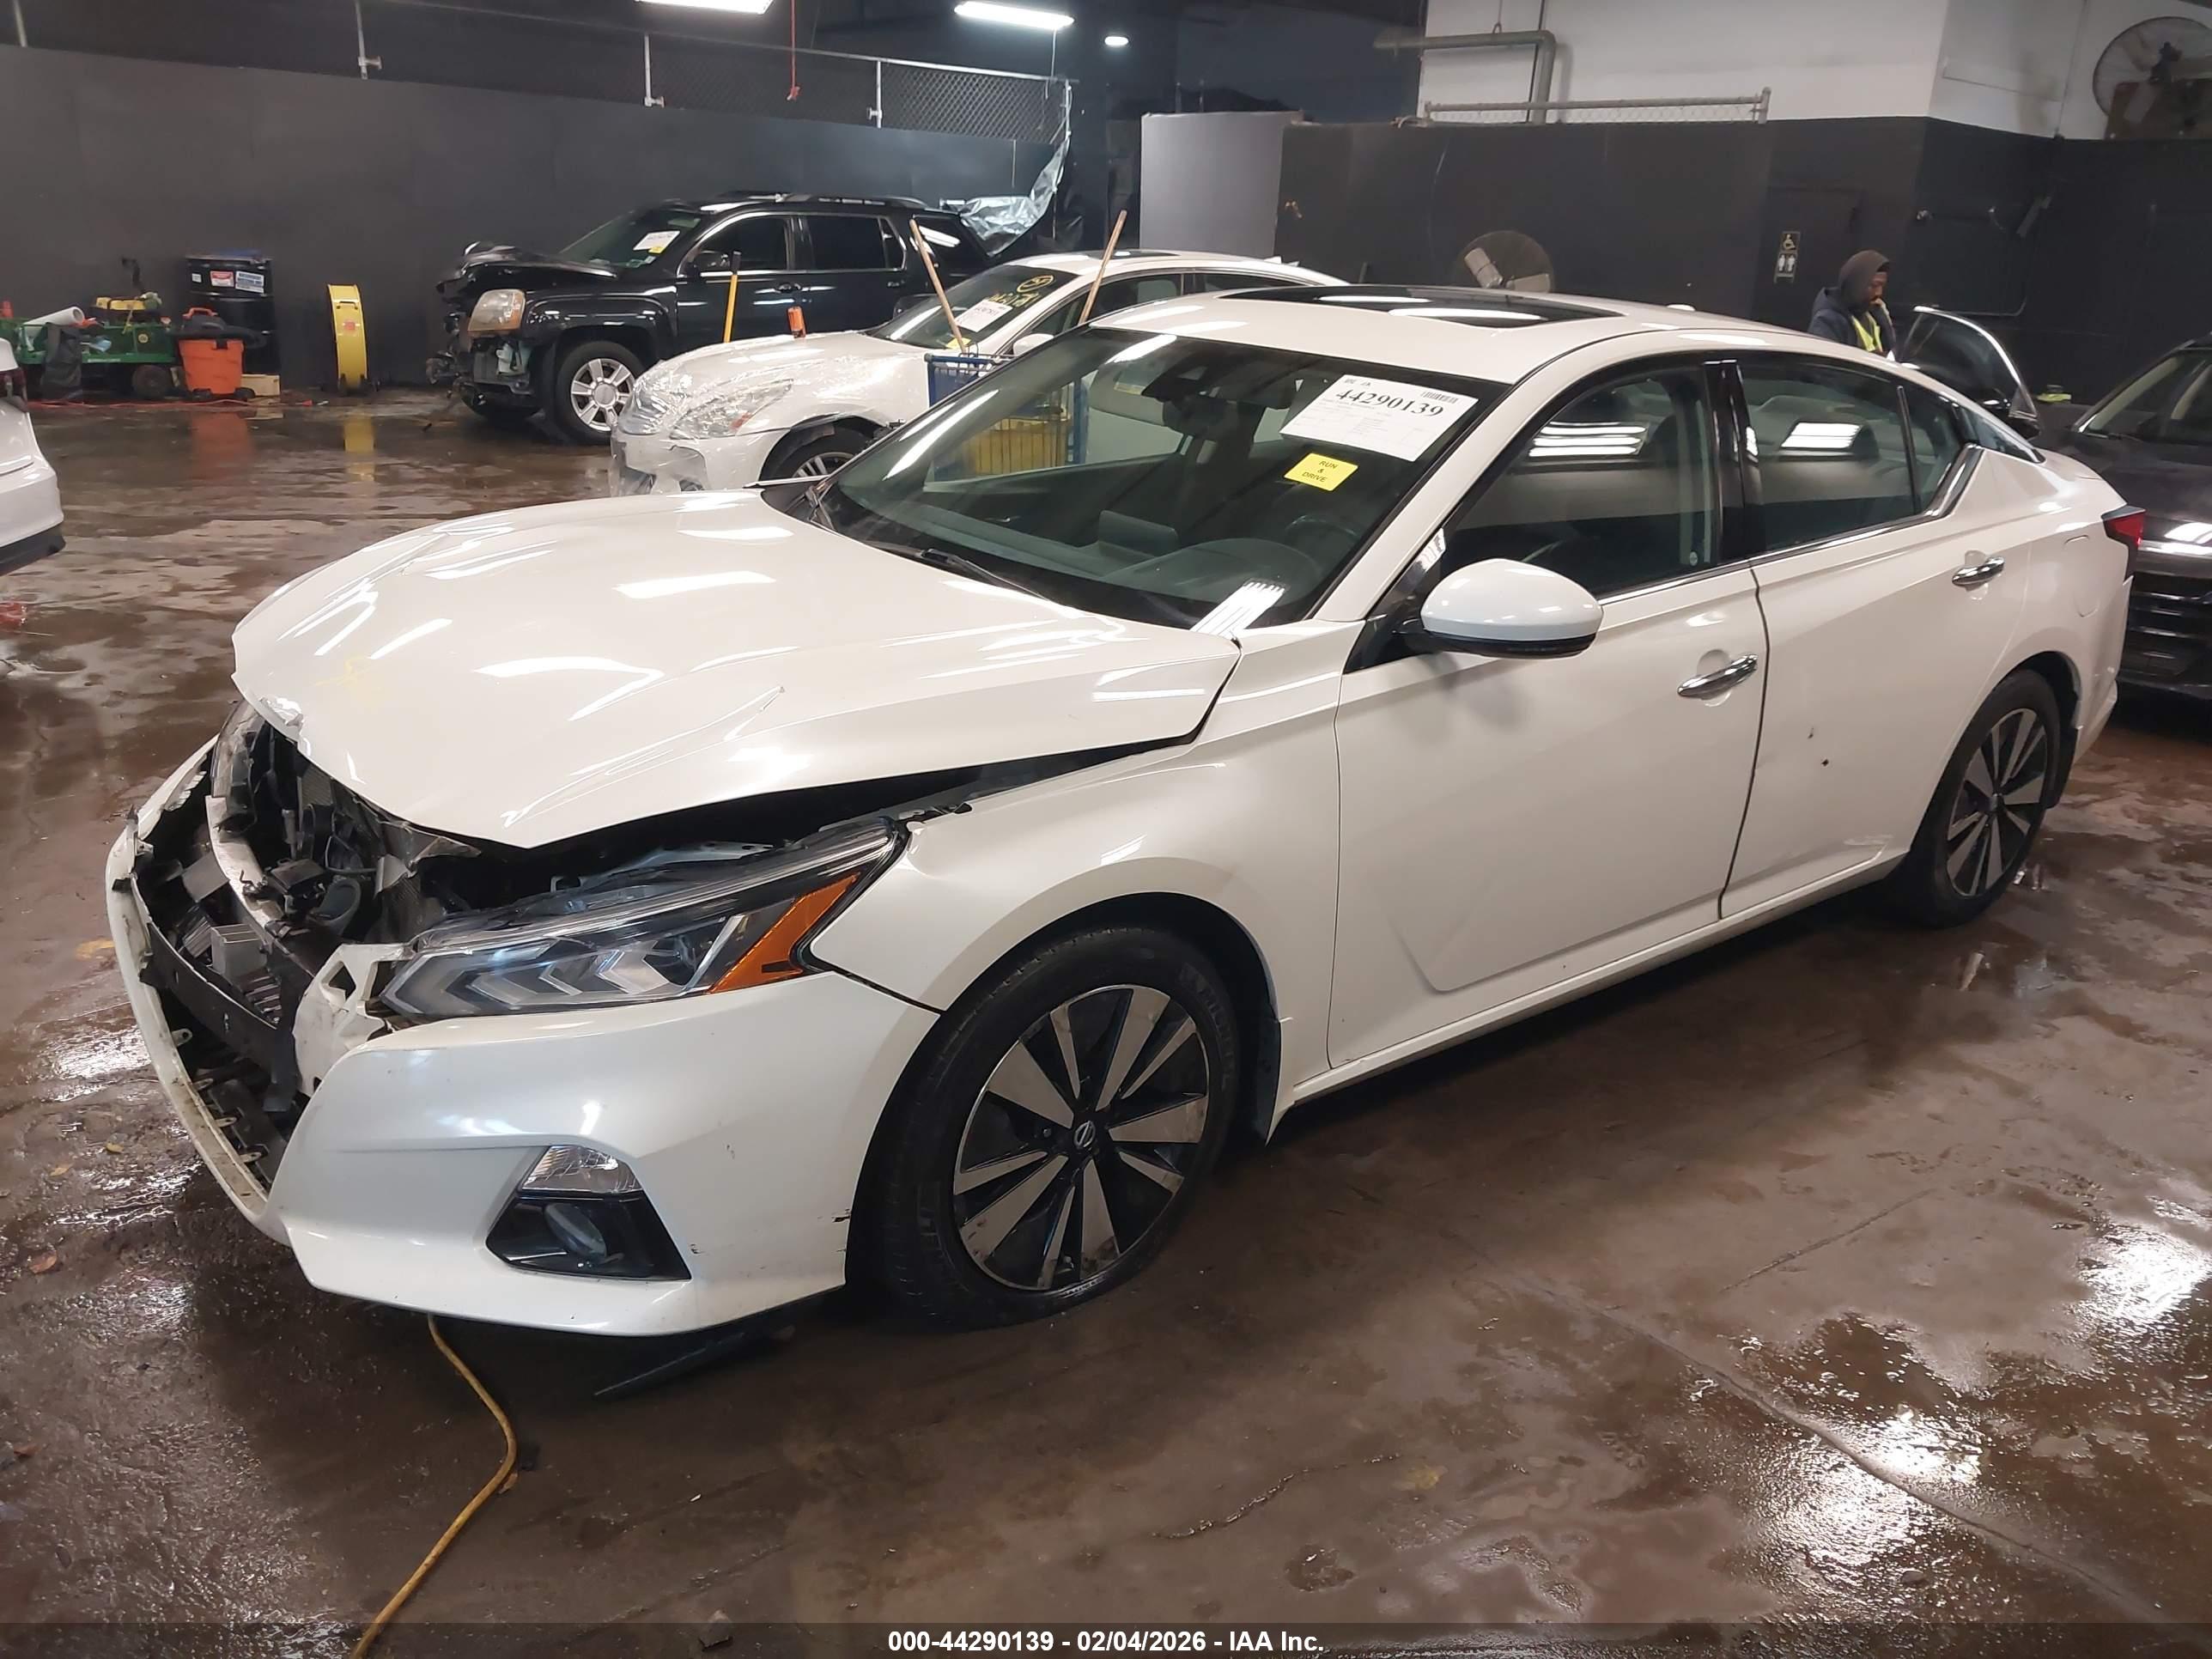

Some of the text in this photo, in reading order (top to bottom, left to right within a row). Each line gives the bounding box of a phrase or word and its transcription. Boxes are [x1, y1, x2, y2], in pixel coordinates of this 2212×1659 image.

[1335, 389, 1443, 416] 44290139
[1319, 460, 1338, 470] RUN
[1302, 471, 1328, 483] DRIVE
